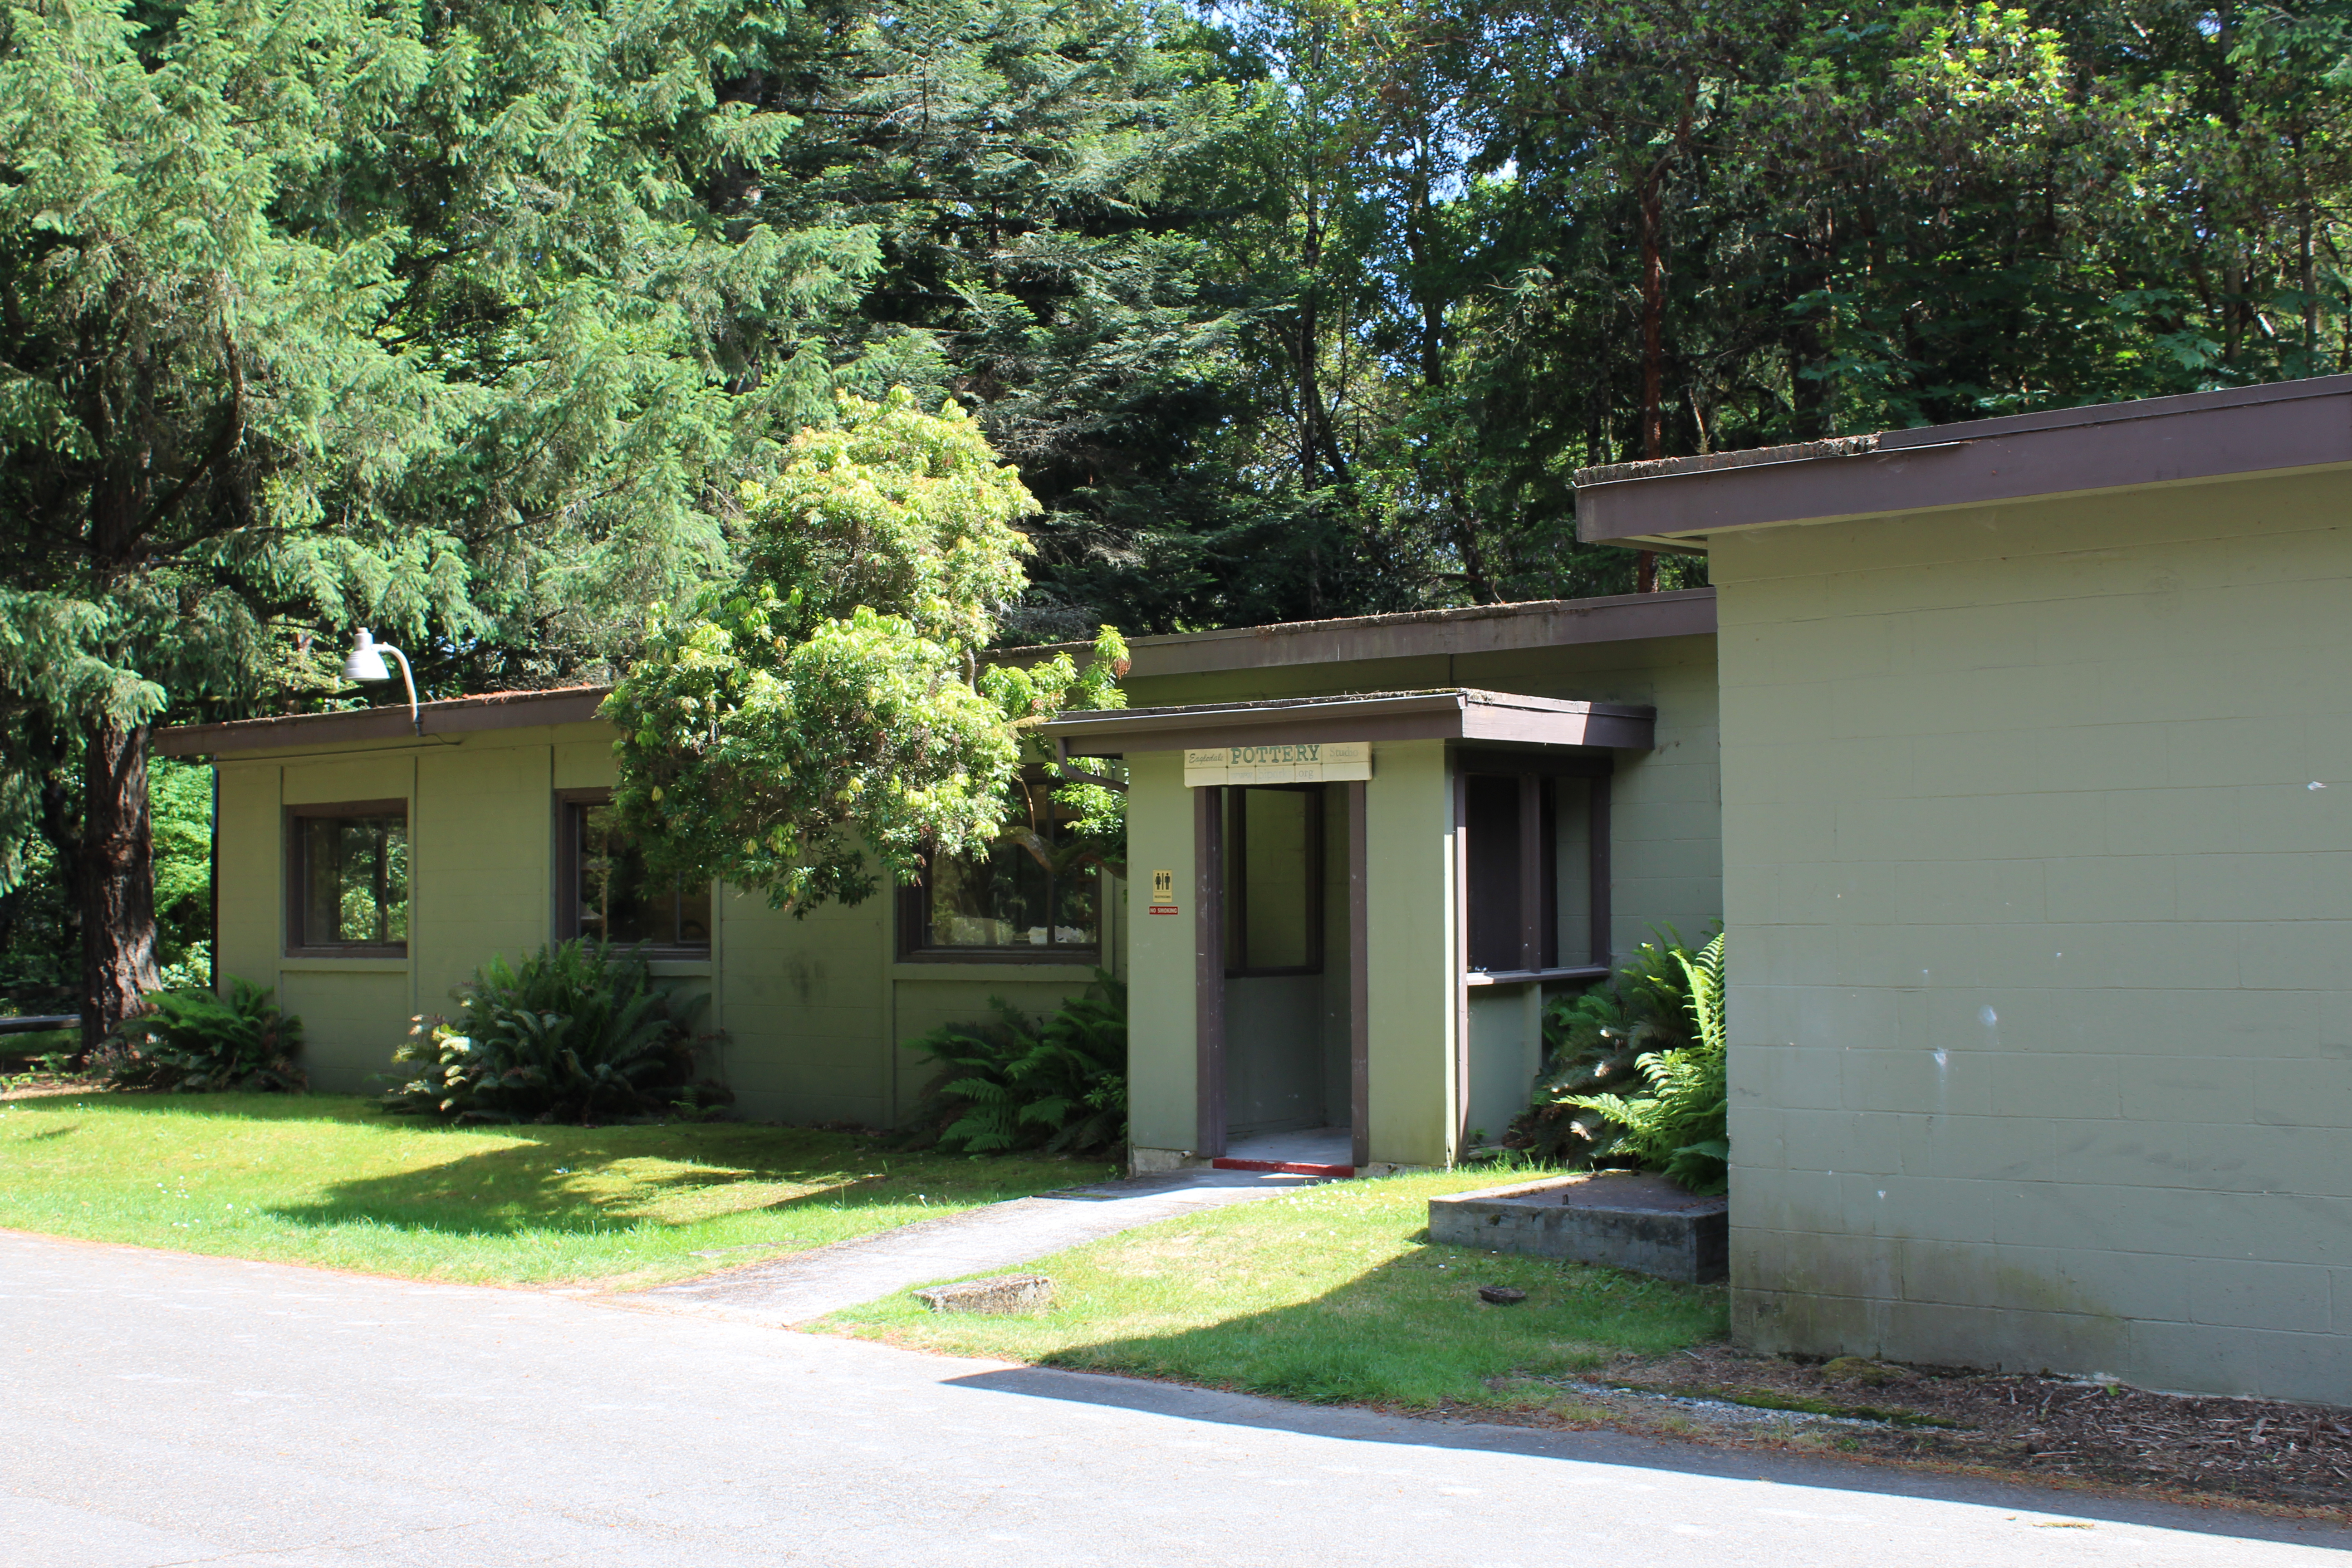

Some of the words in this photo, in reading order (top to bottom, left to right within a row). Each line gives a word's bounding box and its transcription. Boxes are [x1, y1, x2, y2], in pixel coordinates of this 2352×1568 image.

[1189, 753, 1224, 765] Eagledale
[1231, 745, 1319, 764] POTTERY
[1330, 746, 1359, 757] Studio
